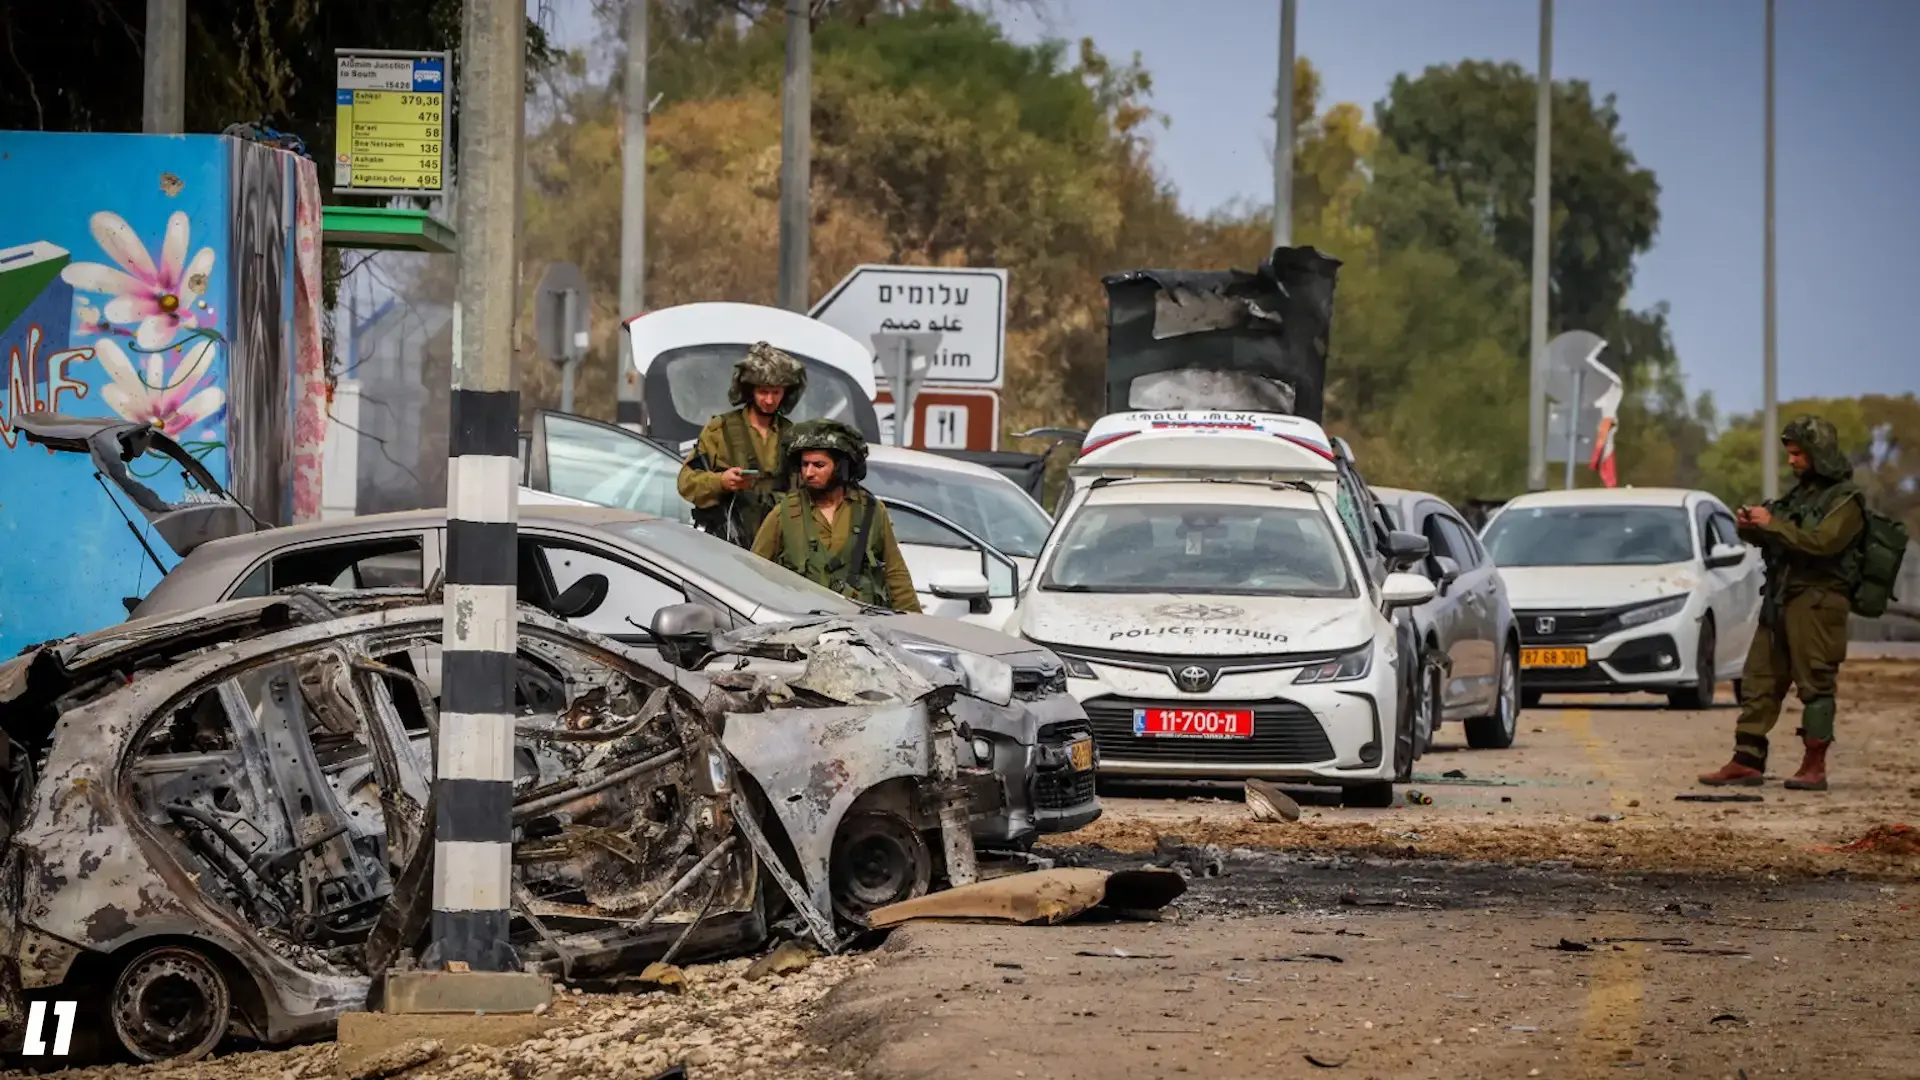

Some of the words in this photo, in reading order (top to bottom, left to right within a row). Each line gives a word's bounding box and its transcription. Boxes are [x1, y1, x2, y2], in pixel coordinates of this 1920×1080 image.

[352, 70, 377, 78] South
[400, 95, 440, 106] 379,36
[418, 112, 440, 121] 479
[425, 128, 440, 137] 58
[420, 144, 439, 153] 136
[419, 160, 438, 169] 145
[417, 175, 438, 185] 495
[879, 284, 969, 306] עלומים
[1109, 626, 1196, 641] POLICE
[1203, 626, 1289, 643] משטרה
